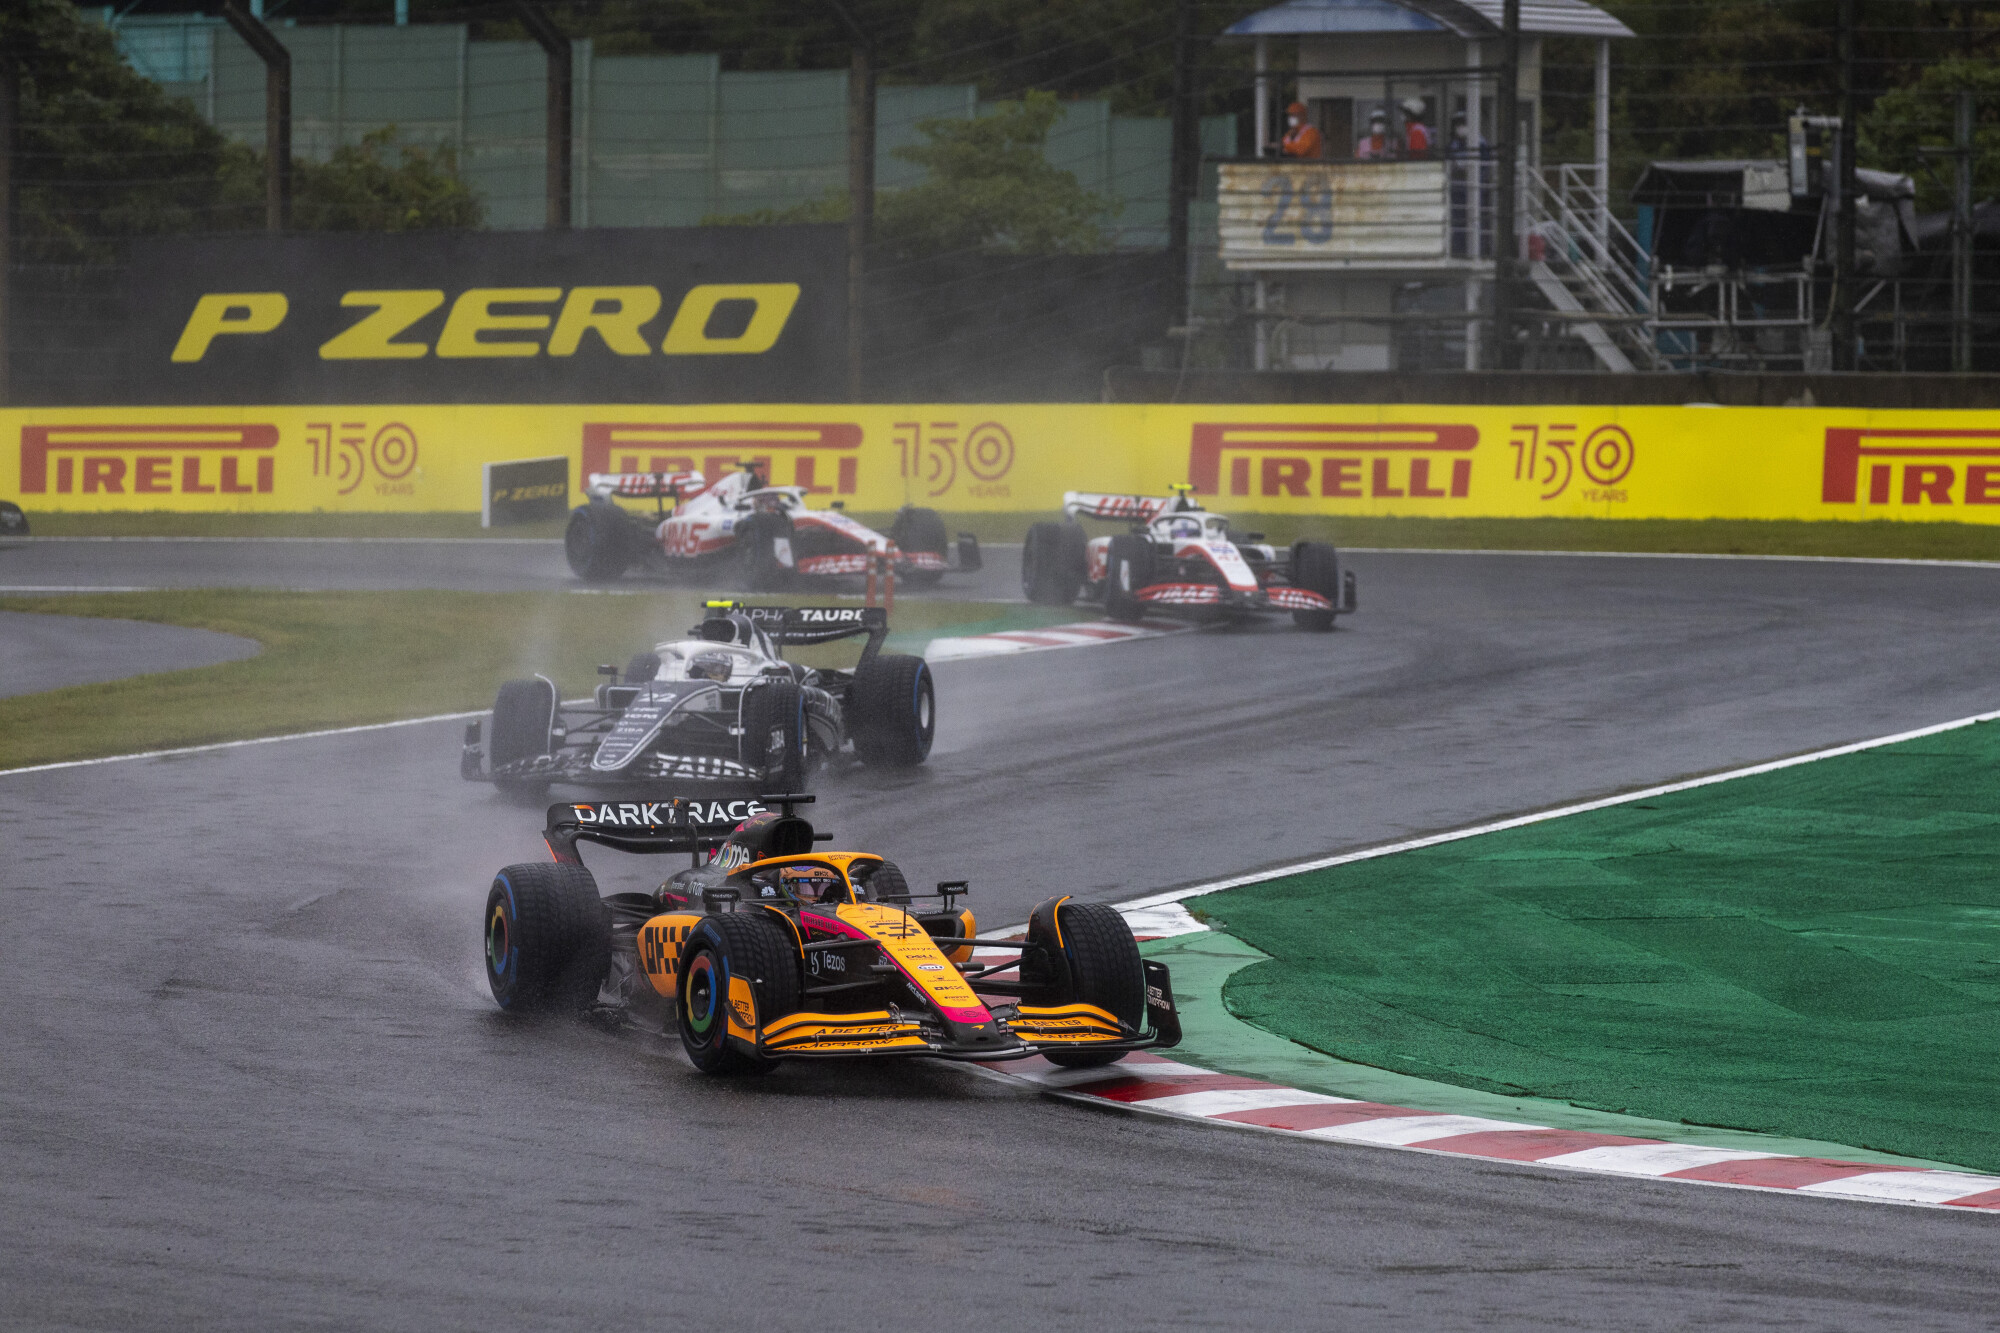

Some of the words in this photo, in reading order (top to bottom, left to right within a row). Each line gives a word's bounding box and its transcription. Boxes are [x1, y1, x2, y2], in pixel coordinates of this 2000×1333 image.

[1261, 172, 1333, 244] 28
[171, 293, 289, 362] P
[319, 283, 801, 359] ZERO
[19, 423, 280, 494] PIRELLI
[306, 422, 418, 495] 150
[373, 483, 415, 496] YEARS
[892, 421, 1015, 496] 150
[968, 485, 1010, 497] YEARS
[1188, 422, 1480, 498] PIRELLI
[1509, 424, 1635, 500] 150
[1821, 427, 2000, 504] PIRE
[1581, 488, 1629, 502] YEARS
[571, 800, 767, 825] DARKTRACE
[822, 950, 846, 972] Tezos
[906, 982, 926, 1005] McLaren
[832, 1024, 900, 1034] BETTER
